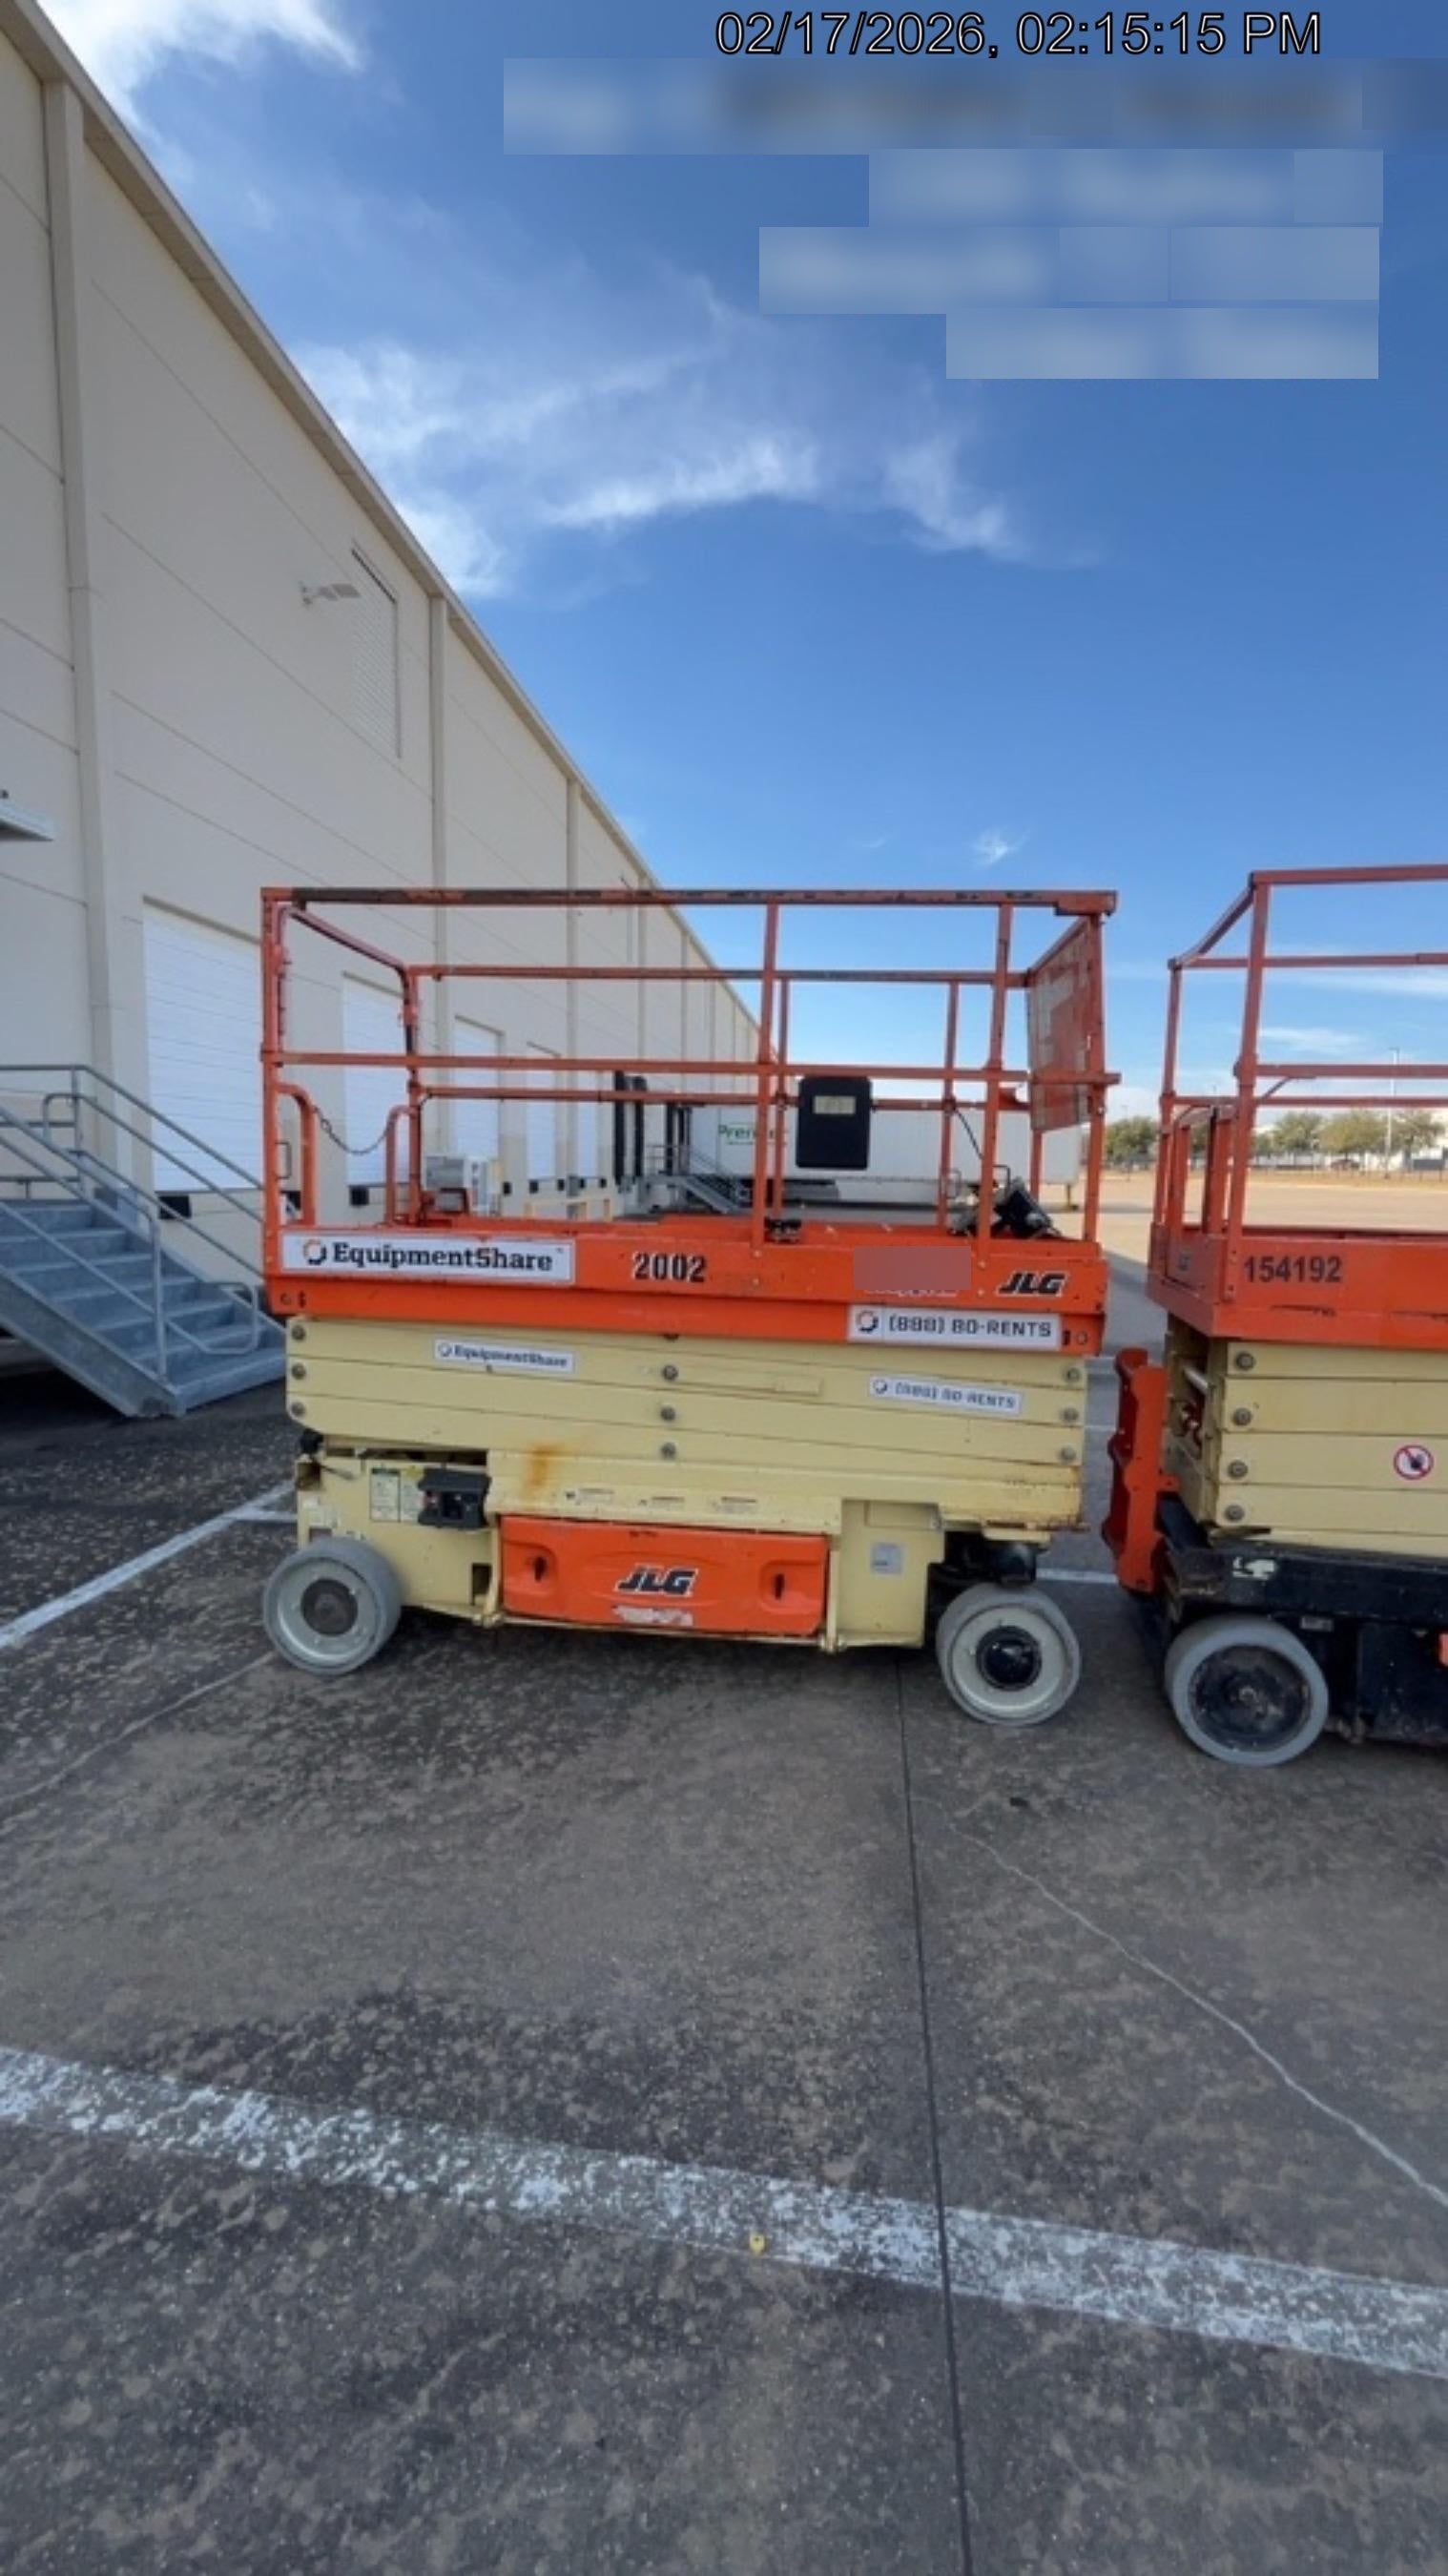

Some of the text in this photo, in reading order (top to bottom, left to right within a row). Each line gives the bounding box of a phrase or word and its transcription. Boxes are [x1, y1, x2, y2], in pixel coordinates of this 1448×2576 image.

[332, 1241, 553, 1271] EquipmentShare
[629, 1253, 707, 1283] 2002
[1243, 1255, 1342, 1283] 154192
[997, 1271, 1068, 1295] JLG
[615, 1564, 698, 1595] JLG
